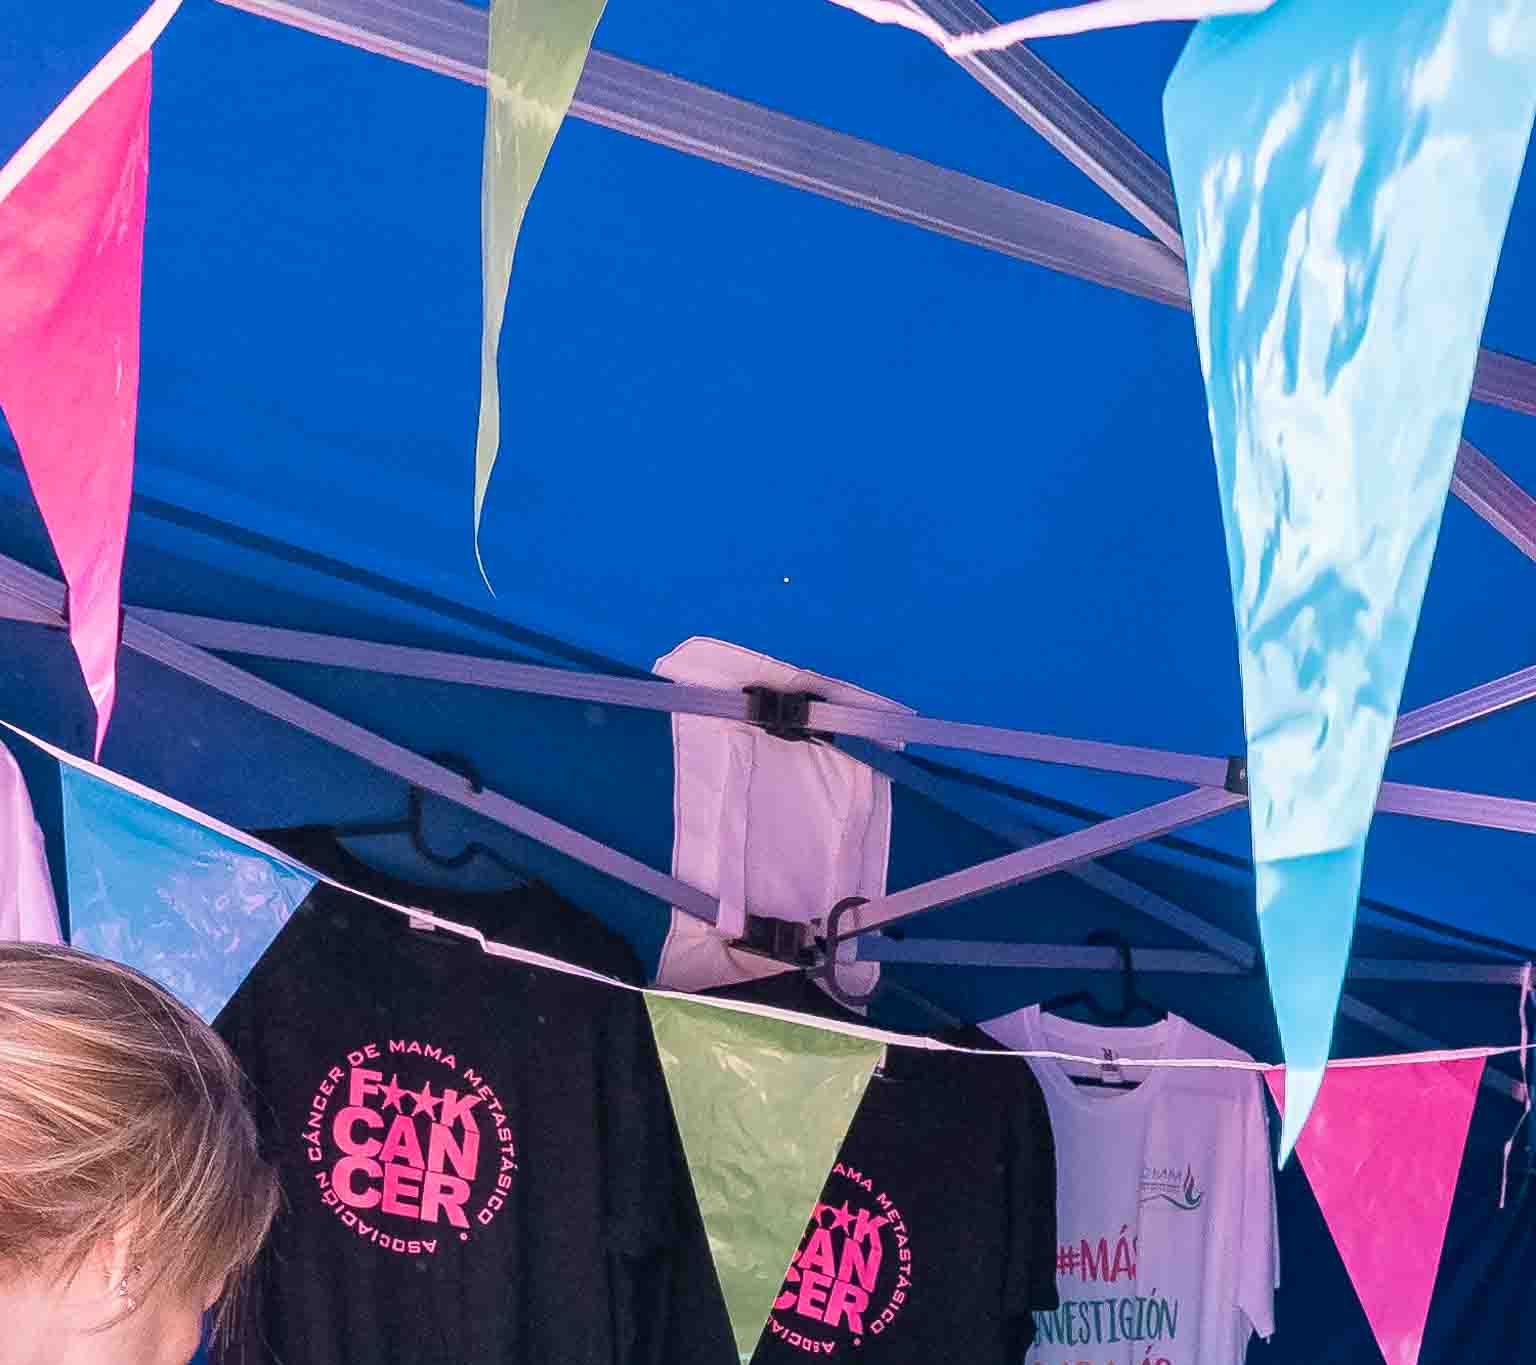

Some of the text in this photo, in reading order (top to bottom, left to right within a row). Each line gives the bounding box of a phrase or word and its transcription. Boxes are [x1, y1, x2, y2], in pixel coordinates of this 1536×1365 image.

[307, 1039, 519, 1227] CÁNCER DE MAMA METASTÁSICO
[331, 1105, 482, 1182] CAN
[331, 1155, 474, 1229] CER
[795, 1223, 885, 1295] AN
[872, 1191, 913, 1336] METASTÁSICO
